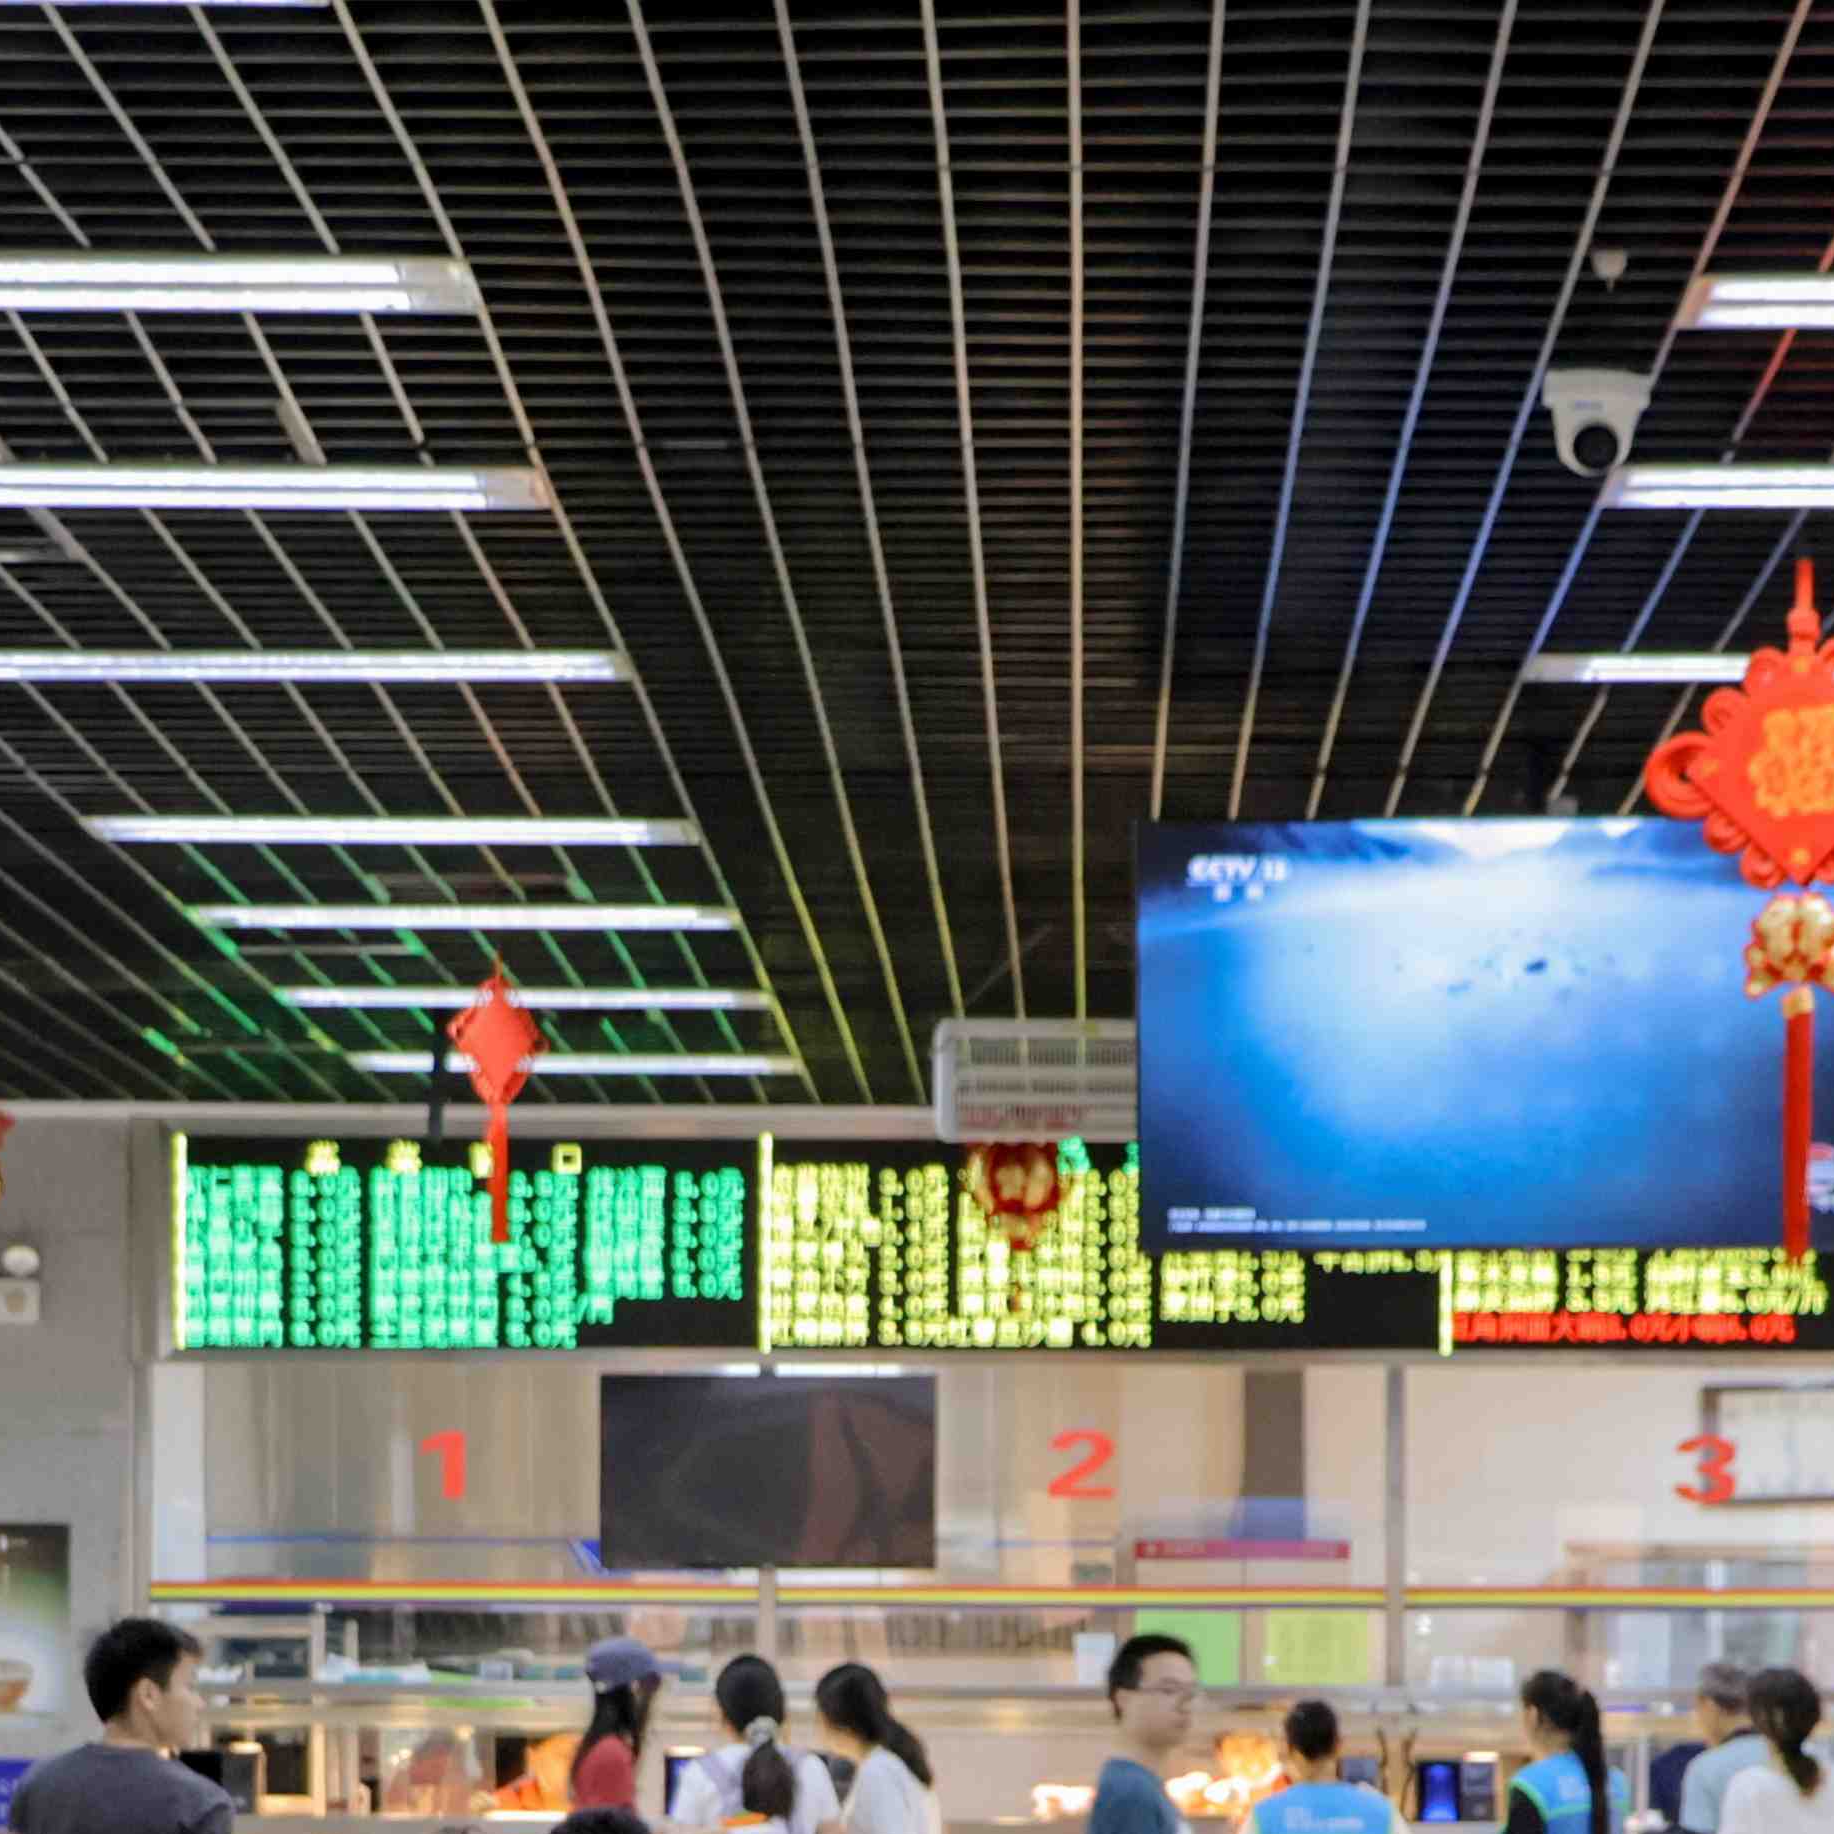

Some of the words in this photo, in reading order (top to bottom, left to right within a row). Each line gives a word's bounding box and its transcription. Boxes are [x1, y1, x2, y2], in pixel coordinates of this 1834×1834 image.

[420, 1432, 467, 1500] 1
[1048, 1431, 1116, 1500] 2
[1674, 1434, 1737, 1504] 3
